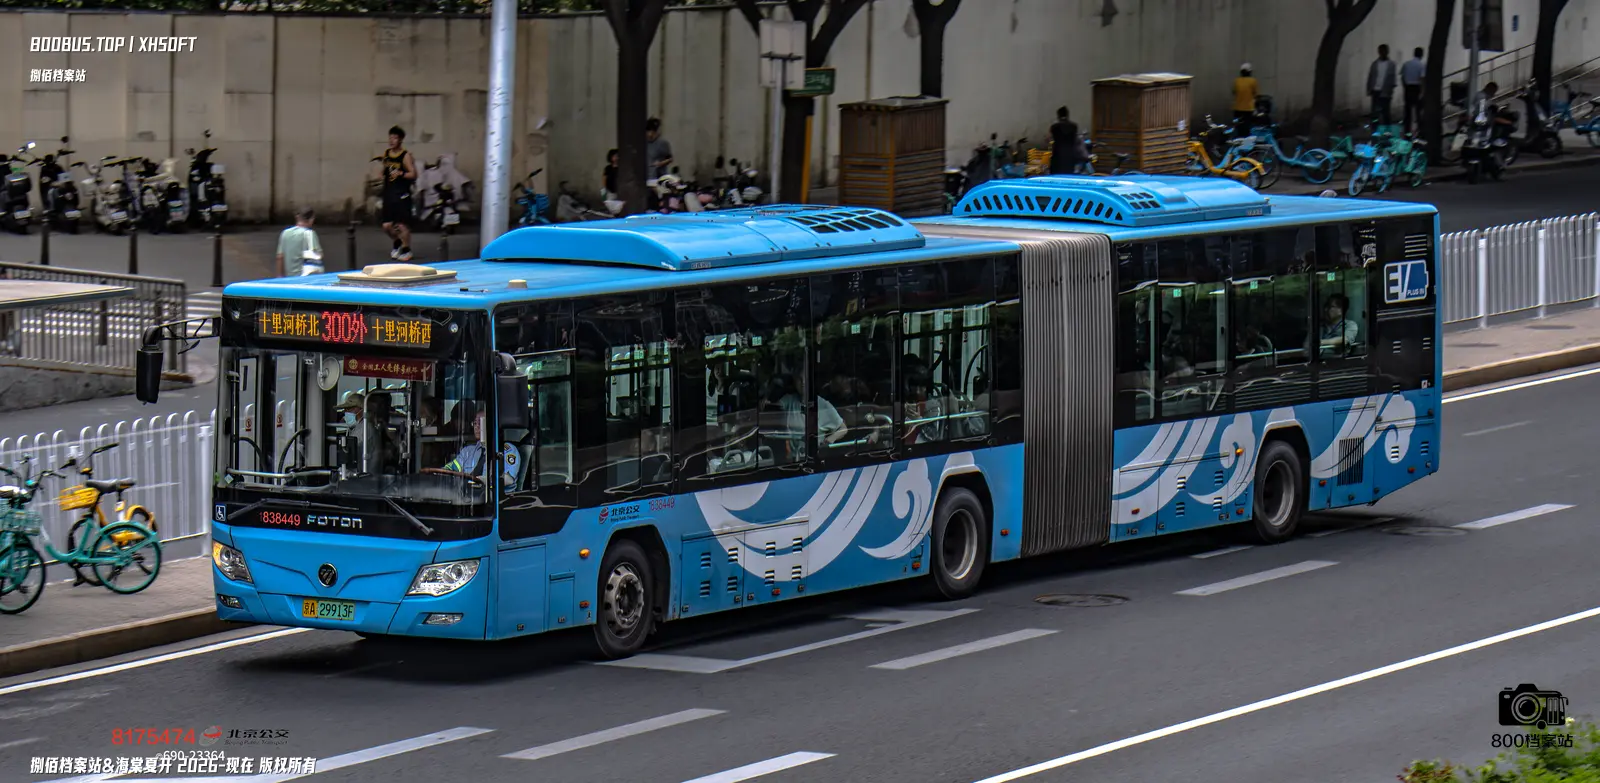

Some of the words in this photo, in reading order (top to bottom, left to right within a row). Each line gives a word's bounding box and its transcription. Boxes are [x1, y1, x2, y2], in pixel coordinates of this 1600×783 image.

[259, 311, 320, 337] 十里河桥北
[321, 311, 368, 344] 300外
[372, 318, 431, 344] 十里河桥西
[611, 505, 640, 516] 北京公交
[307, 514, 362, 528] FOTON
